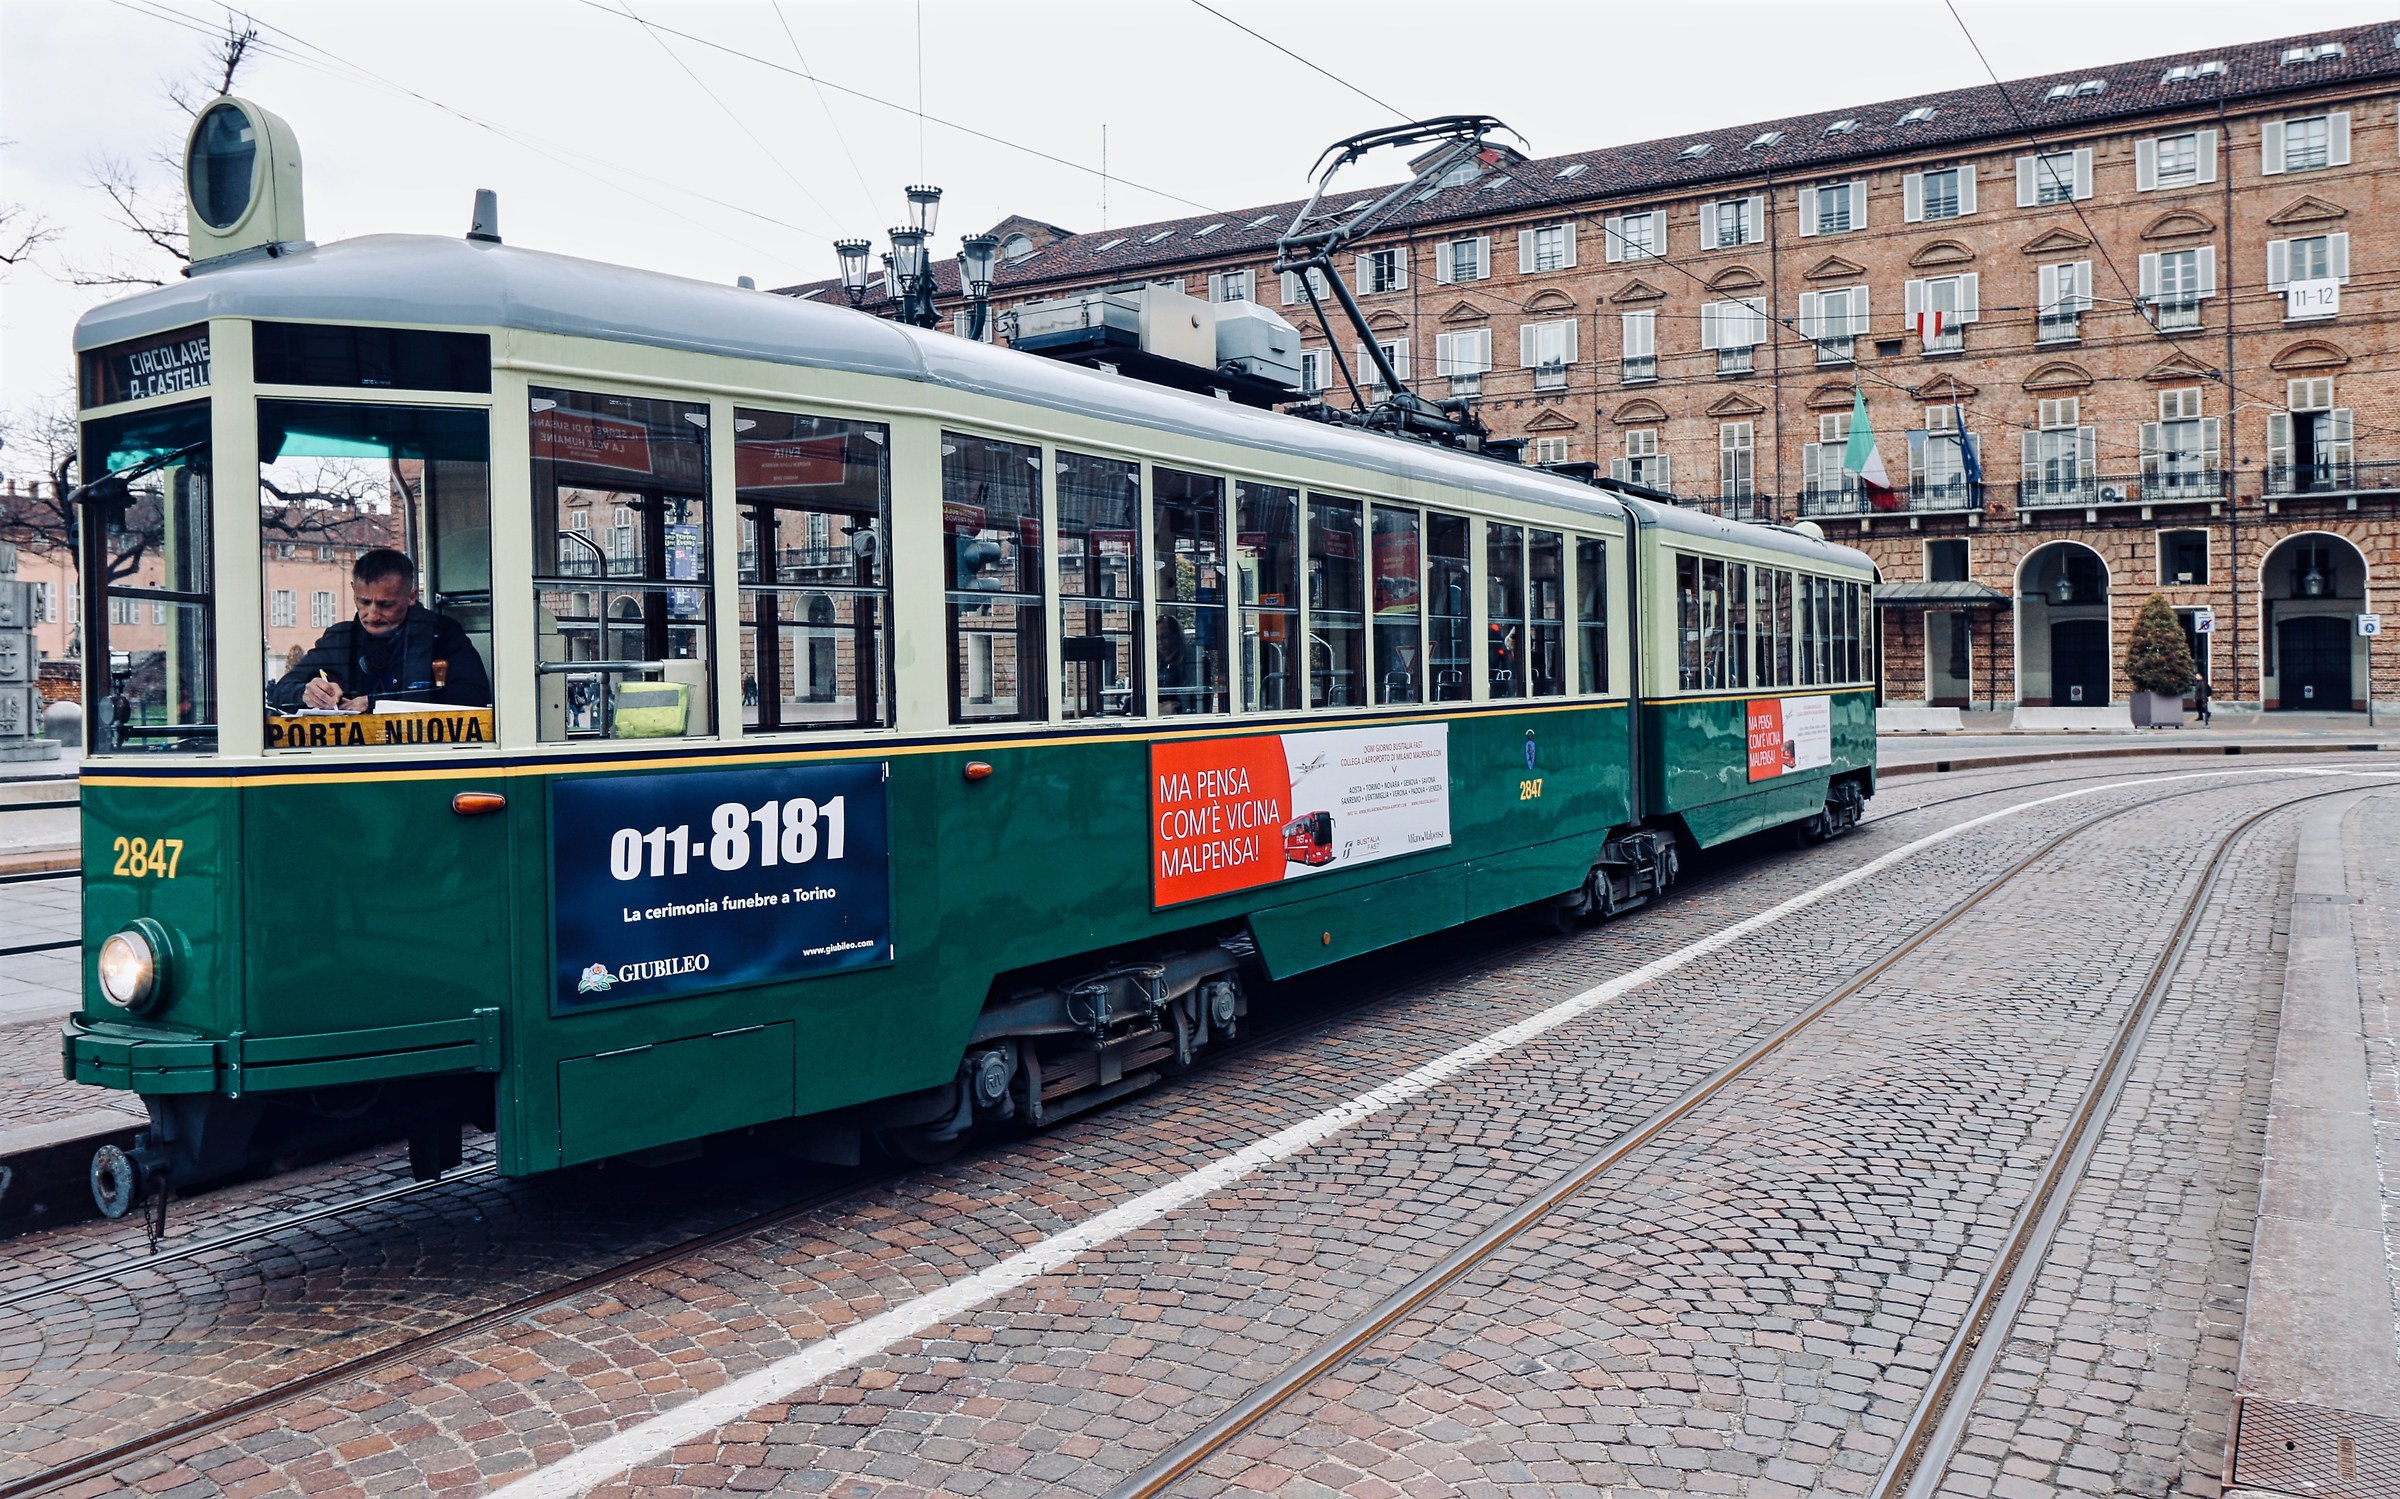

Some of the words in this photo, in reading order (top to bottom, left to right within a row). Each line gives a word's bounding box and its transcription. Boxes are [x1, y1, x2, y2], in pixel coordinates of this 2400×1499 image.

[2294, 287, 2334, 307] 11-12
[129, 338, 210, 376] CIRCOLARE
[268, 721, 367, 747] PORTA
[385, 716, 484, 745] NUOVA
[1160, 771, 1192, 804] MA
[1197, 767, 1250, 800] PENSA
[1520, 778, 1542, 800] 2847
[1225, 798, 1280, 831] VICINA
[610, 795, 845, 881] 011-8181
[1356, 836, 1381, 847] BUSITALIA
[113, 836, 184, 879] 2847
[1161, 835, 1260, 879] MALPENSA!
[623, 907, 641, 923] La
[645, 898, 718, 920] cerimonia
[721, 891, 778, 911] funebre
[781, 891, 790, 905] a
[793, 886, 836, 903] Torino
[802, 938, 874, 957] www.giubileo.com
[618, 953, 710, 983] GIUBILEO
